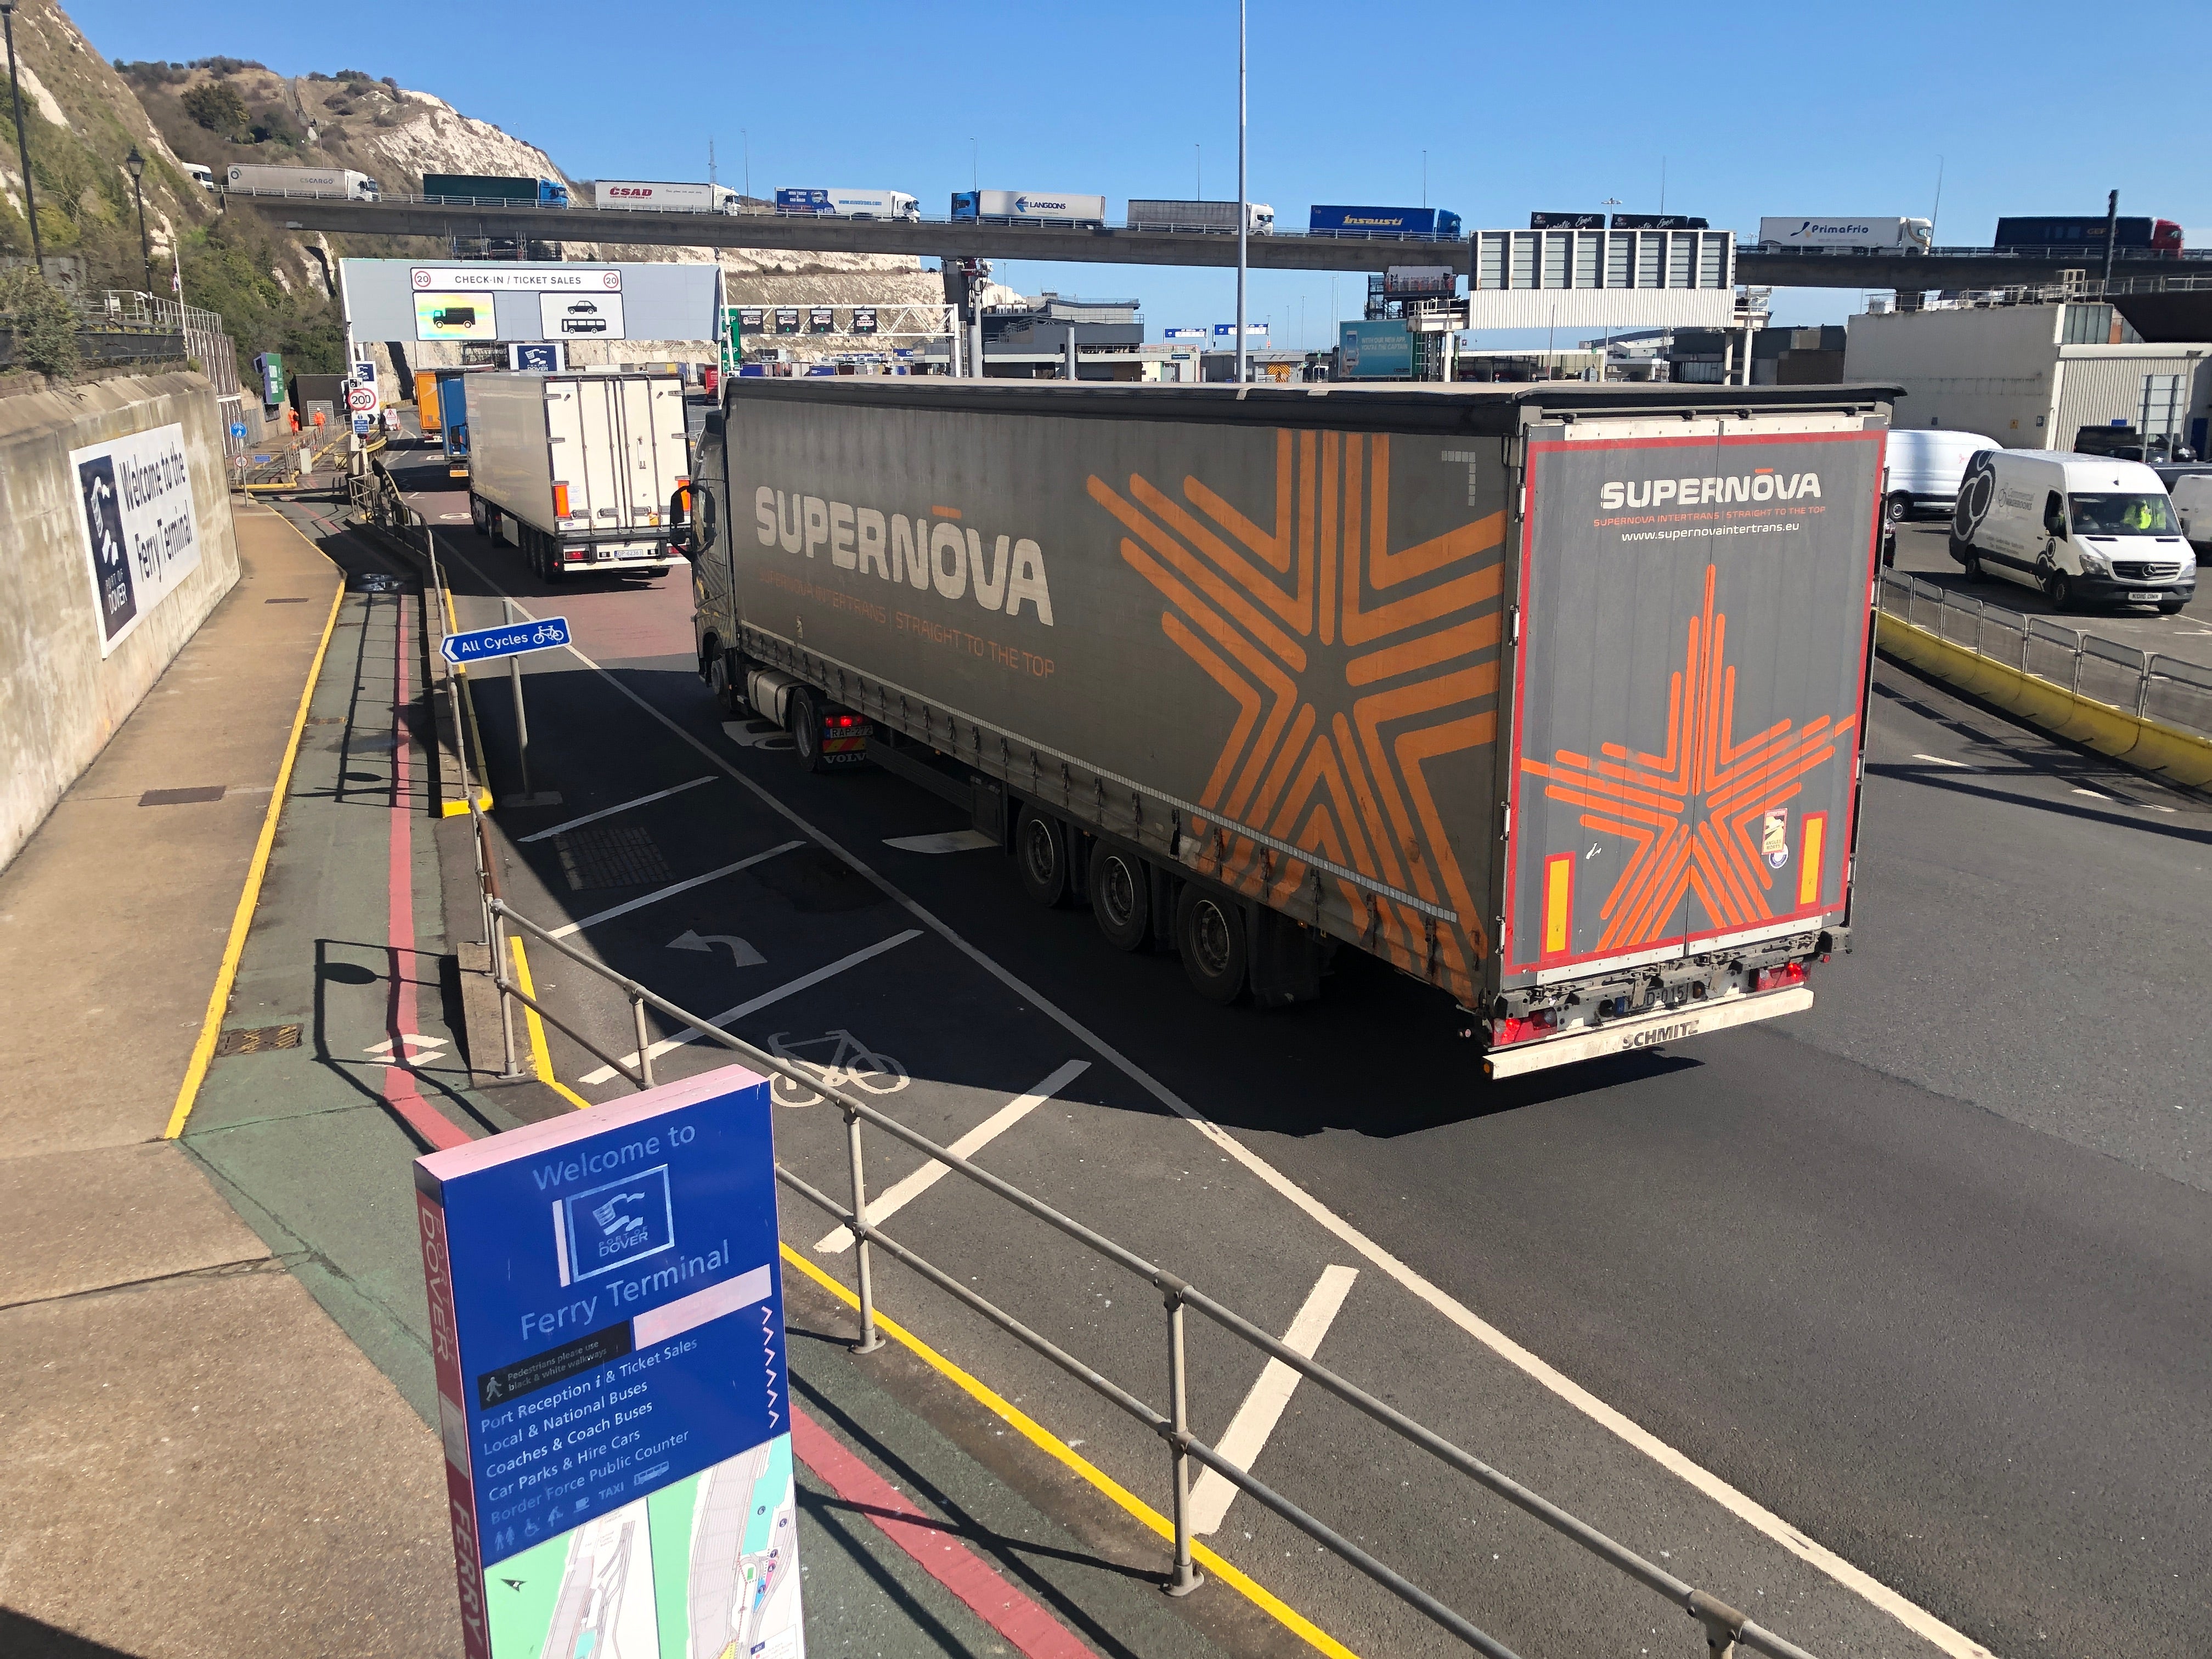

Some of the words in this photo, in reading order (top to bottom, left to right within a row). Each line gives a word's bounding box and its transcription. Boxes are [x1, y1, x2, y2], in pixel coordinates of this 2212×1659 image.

[610, 187, 653, 196] ČSAD
[1812, 224, 1869, 233] PrimaFrio
[455, 276, 504, 284] CHECK-IN
[514, 276, 548, 284] TICKET
[551, 276, 582, 285] SALES
[352, 396, 365, 404] 20
[119, 454, 164, 512] Welcome
[161, 451, 173, 490] to
[171, 442, 186, 487] the
[1593, 516, 1656, 527] SUPERNOVA
[1657, 511, 1720, 522] INTERTRANS
[1725, 509, 1771, 521] STRAIGHT
[1787, 507, 1806, 515] THE
[1808, 506, 1826, 514] TOP
[1621, 522, 1800, 542] www.supernovaintertrans.eu
[134, 532, 162, 583] Ferry
[157, 499, 194, 561] Terminal
[105, 573, 117, 592] PORT
[117, 568, 123, 582] OF
[108, 582, 128, 615] DOVER
[462, 640, 481, 653] All
[484, 635, 529, 650] Cycles
[816, 585, 886, 624] INTERTRANS
[895, 611, 961, 646] STRAIGHT
[968, 634, 984, 657] TO
[988, 641, 1018, 669] THE
[1022, 653, 1055, 679] TOP
[832, 726, 872, 736] RAP-272
[1622, 1019, 1700, 1049] SCHMITZ
[532, 1133, 661, 1192] Welcome
[669, 1124, 696, 1149] to
[599, 1233, 629, 1248] PORT
[634, 1225, 648, 1235] OF
[599, 1232, 648, 1257] DOVER
[421, 1206, 449, 1361] DOVER
[520, 1294, 599, 1342] Ferry
[606, 1239, 730, 1307] Terminal
[507, 1357, 556, 1381] Pedestrians
[557, 1347, 583, 1366] please
[585, 1340, 600, 1352] use
[508, 1376, 532, 1392] black
[533, 1373, 540, 1381] &
[541, 1364, 566, 1378] white
[567, 1348, 608, 1371] walkways
[481, 1409, 514, 1433] Port
[518, 1380, 591, 1419] Reception
[606, 1370, 616, 1384] &
[619, 1353, 662, 1378] Ticket
[663, 1338, 698, 1359] Sales
[483, 1428, 523, 1457] Local
[528, 1424, 539, 1438] &
[543, 1396, 605, 1432] National
[609, 1380, 648, 1406] Buses
[486, 1446, 549, 1479] Coaches
[552, 1437, 563, 1452] &
[567, 1418, 611, 1444] Coach
[614, 1401, 653, 1426] Buses
[488, 1482, 514, 1502] Car
[518, 1464, 559, 1490] Parks
[562, 1457, 573, 1471] &
[578, 1443, 607, 1465] Hire
[611, 1430, 641, 1449] Cars
[490, 1492, 543, 1526] Border
[546, 1475, 586, 1501] Force
[589, 1454, 631, 1482] Public
[635, 1429, 690, 1462] Counter
[598, 1481, 625, 1501] TAXI
[453, 1498, 483, 1646] FERRY
